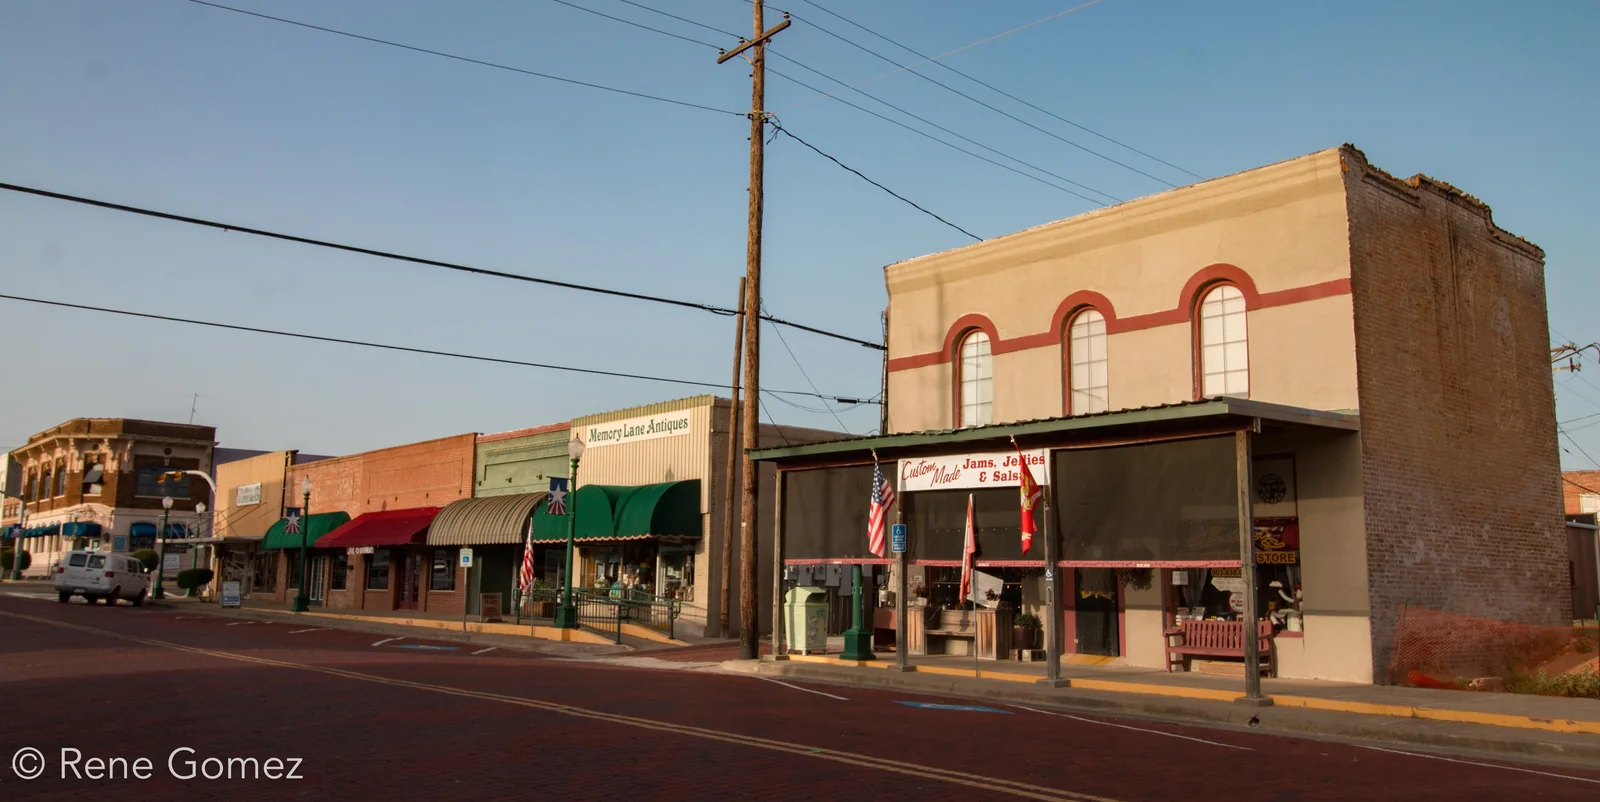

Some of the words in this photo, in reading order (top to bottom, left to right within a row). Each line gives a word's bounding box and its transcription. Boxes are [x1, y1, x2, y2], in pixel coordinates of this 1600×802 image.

[589, 428, 622, 442] Memory
[624, 424, 645, 438] Lane
[646, 418, 688, 434] Antiques
[902, 460, 937, 481] Custom
[930, 464, 961, 487] Made
[979, 471, 987, 482] &
[993, 470, 1021, 482] Sals
[1257, 552, 1295, 564] STORE
